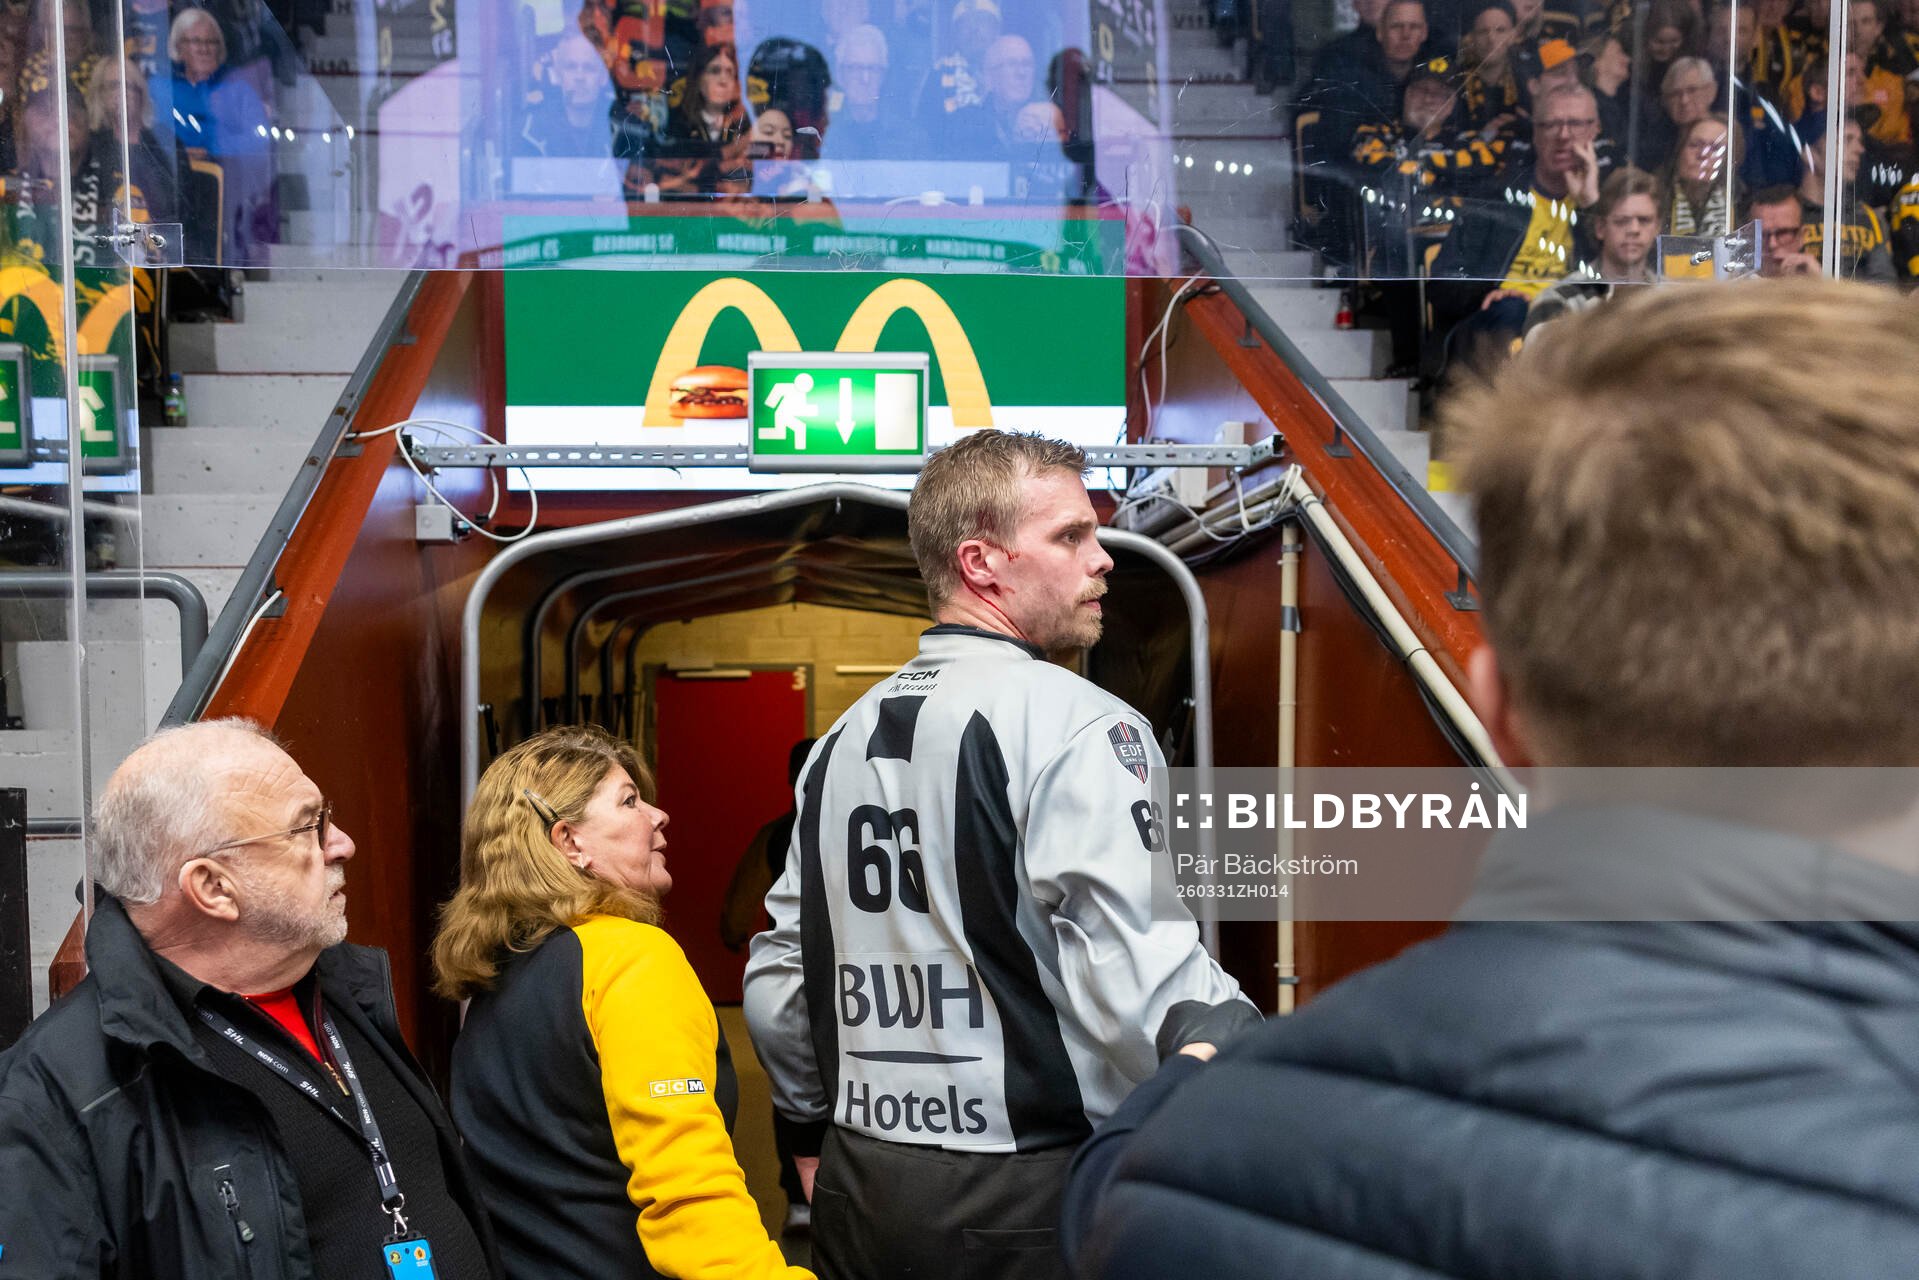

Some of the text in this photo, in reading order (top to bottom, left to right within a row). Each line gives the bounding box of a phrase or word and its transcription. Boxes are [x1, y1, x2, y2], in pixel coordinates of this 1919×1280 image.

[898, 669, 941, 681] CCM
[1119, 743, 1144, 758] EDF
[847, 804, 931, 914] 66
[838, 963, 985, 1030] BWH
[223, 1027, 244, 1045] SHL
[343, 1061, 357, 1080] SHL
[299, 1080, 320, 1098] SHL
[652, 1079, 705, 1096] CCM
[844, 1079, 988, 1135] Hotels
